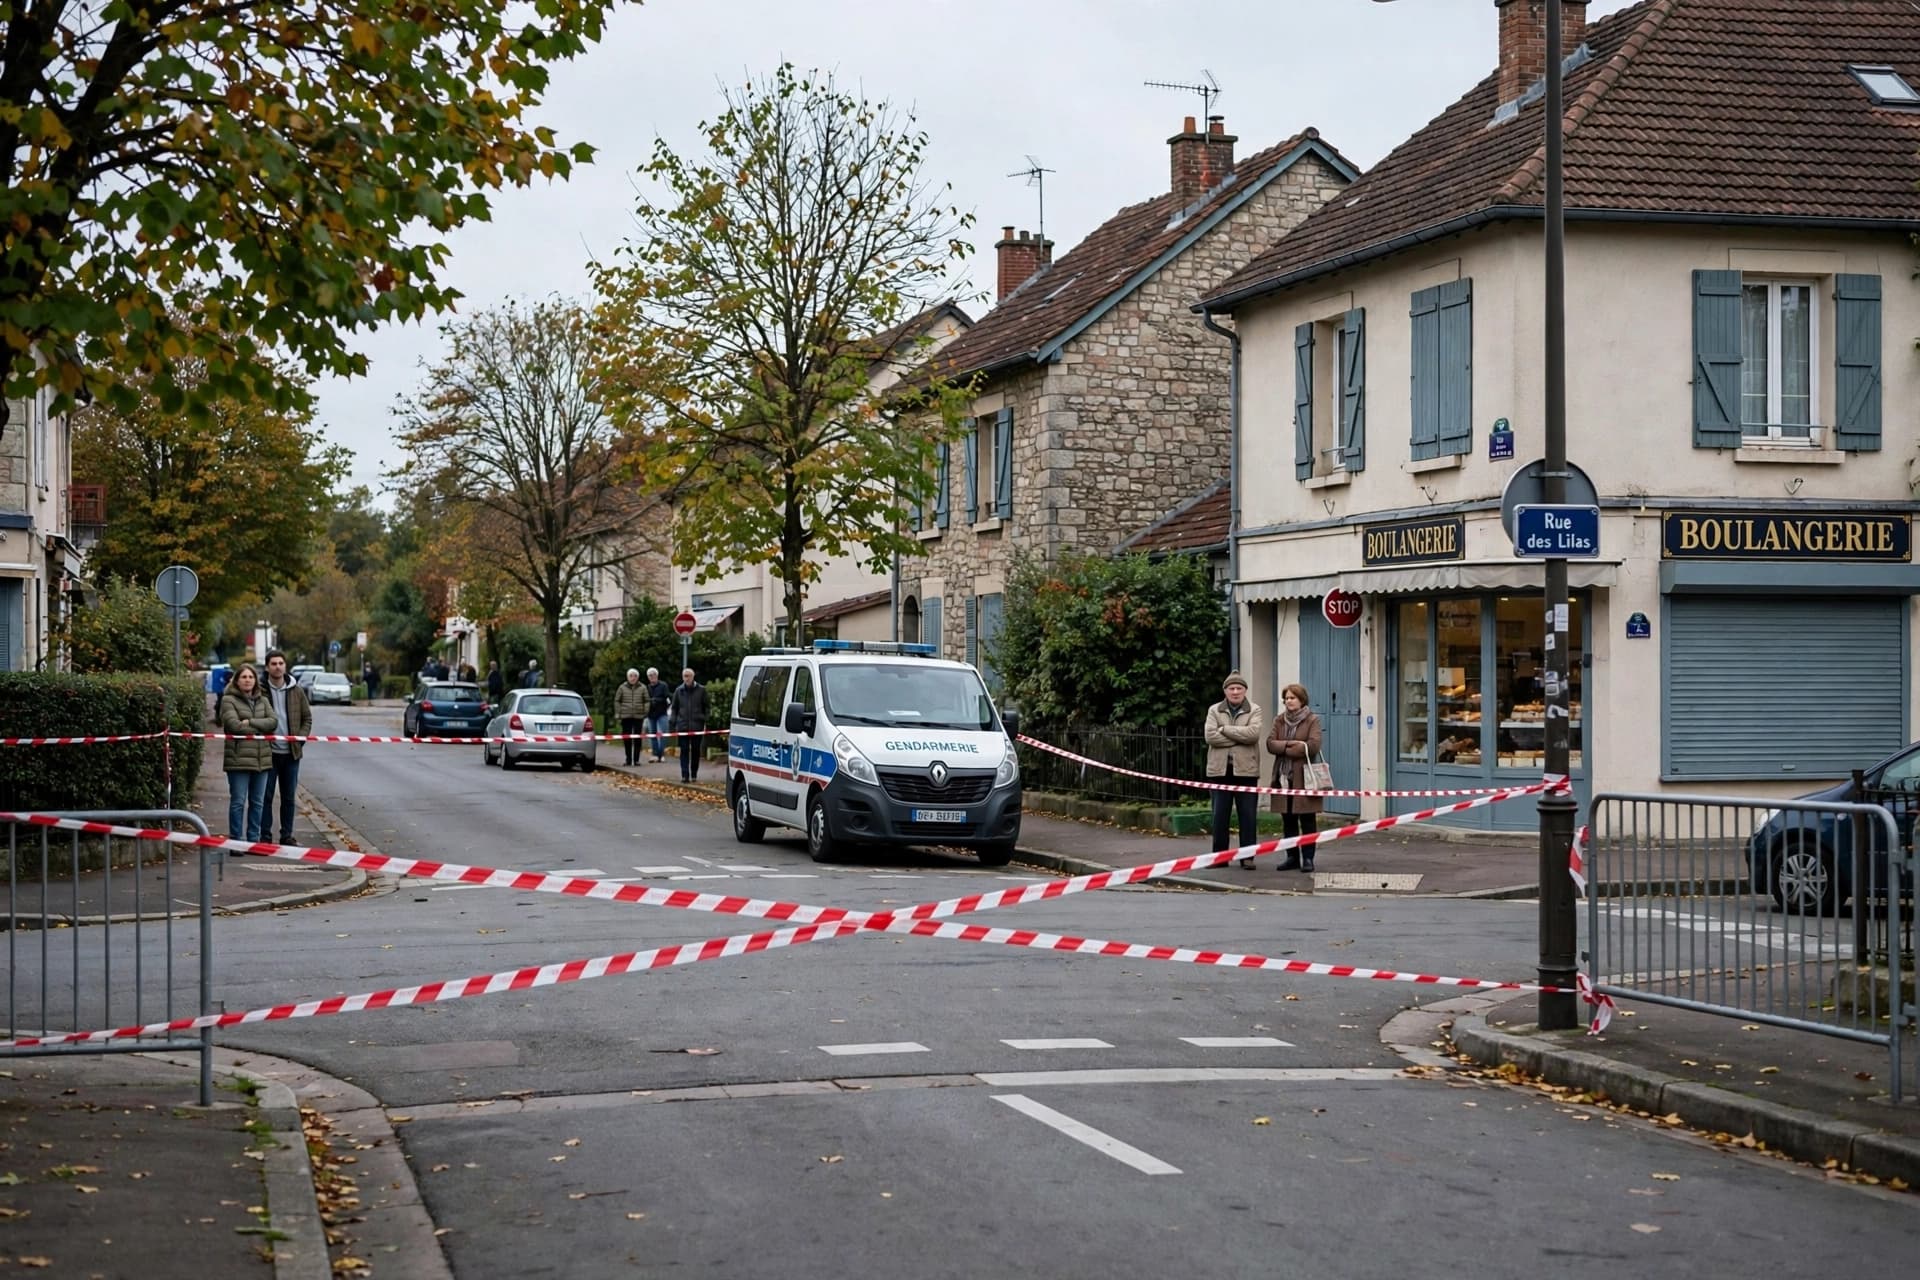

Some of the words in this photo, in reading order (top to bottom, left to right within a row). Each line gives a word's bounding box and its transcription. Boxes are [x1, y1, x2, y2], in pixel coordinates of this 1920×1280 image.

[1544, 512, 1572, 529] Rue
[1367, 524, 1457, 559] BOULANGERIE
[1527, 533, 1552, 548] des
[1558, 533, 1591, 548] Lilas
[1680, 518, 1895, 551] BOULANGERIE
[1328, 600, 1359, 614] STOP
[885, 741, 979, 753] GENDARMERIE
